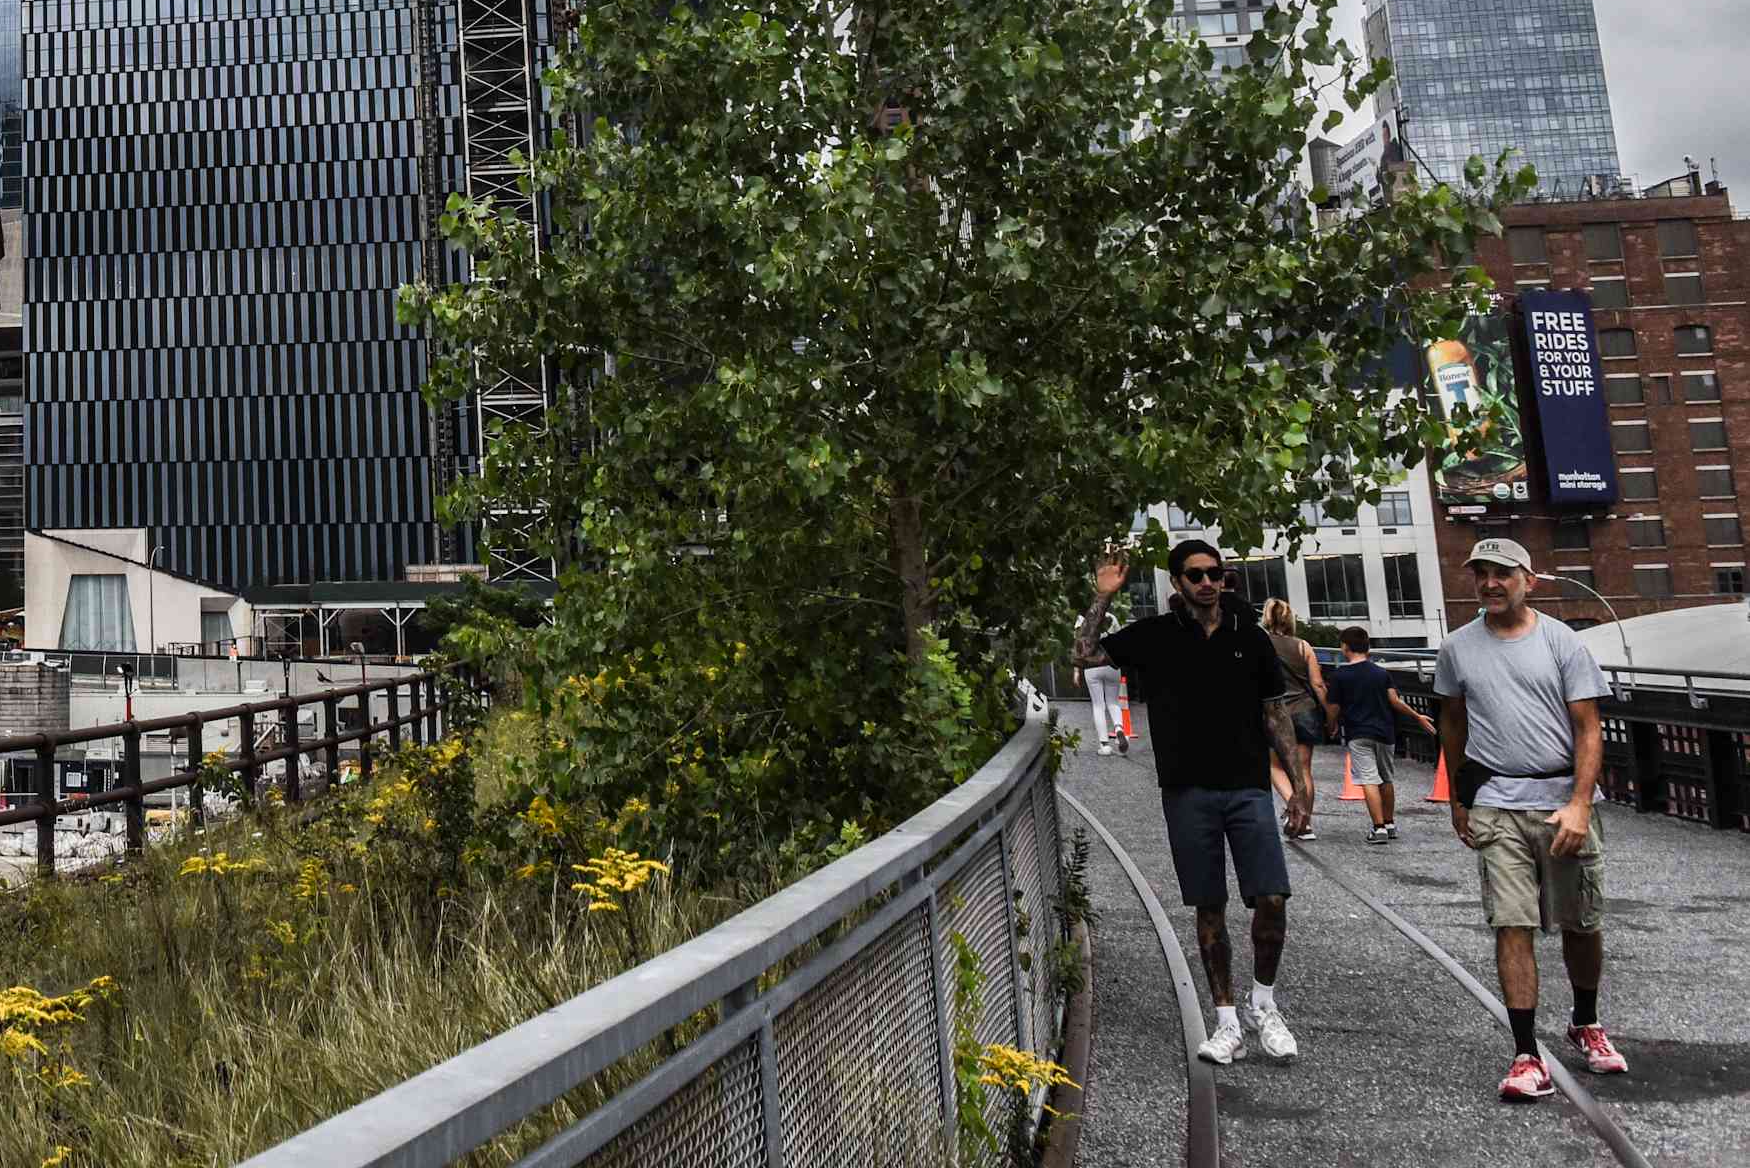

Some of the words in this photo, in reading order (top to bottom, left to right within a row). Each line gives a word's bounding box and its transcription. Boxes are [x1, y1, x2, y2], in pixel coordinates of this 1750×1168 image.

[1531, 311, 1586, 332] FREE
[1534, 333, 1589, 351] RIDES
[1537, 351, 1563, 363] FOR
[1564, 351, 1591, 364] YOU
[1539, 364, 1550, 378] &
[1551, 364, 1593, 378] YOUR
[1541, 379, 1595, 397] STUFF
[1558, 469, 1601, 480] manhattan
[1559, 480, 1577, 489] mini
[1577, 481, 1607, 491] storage
